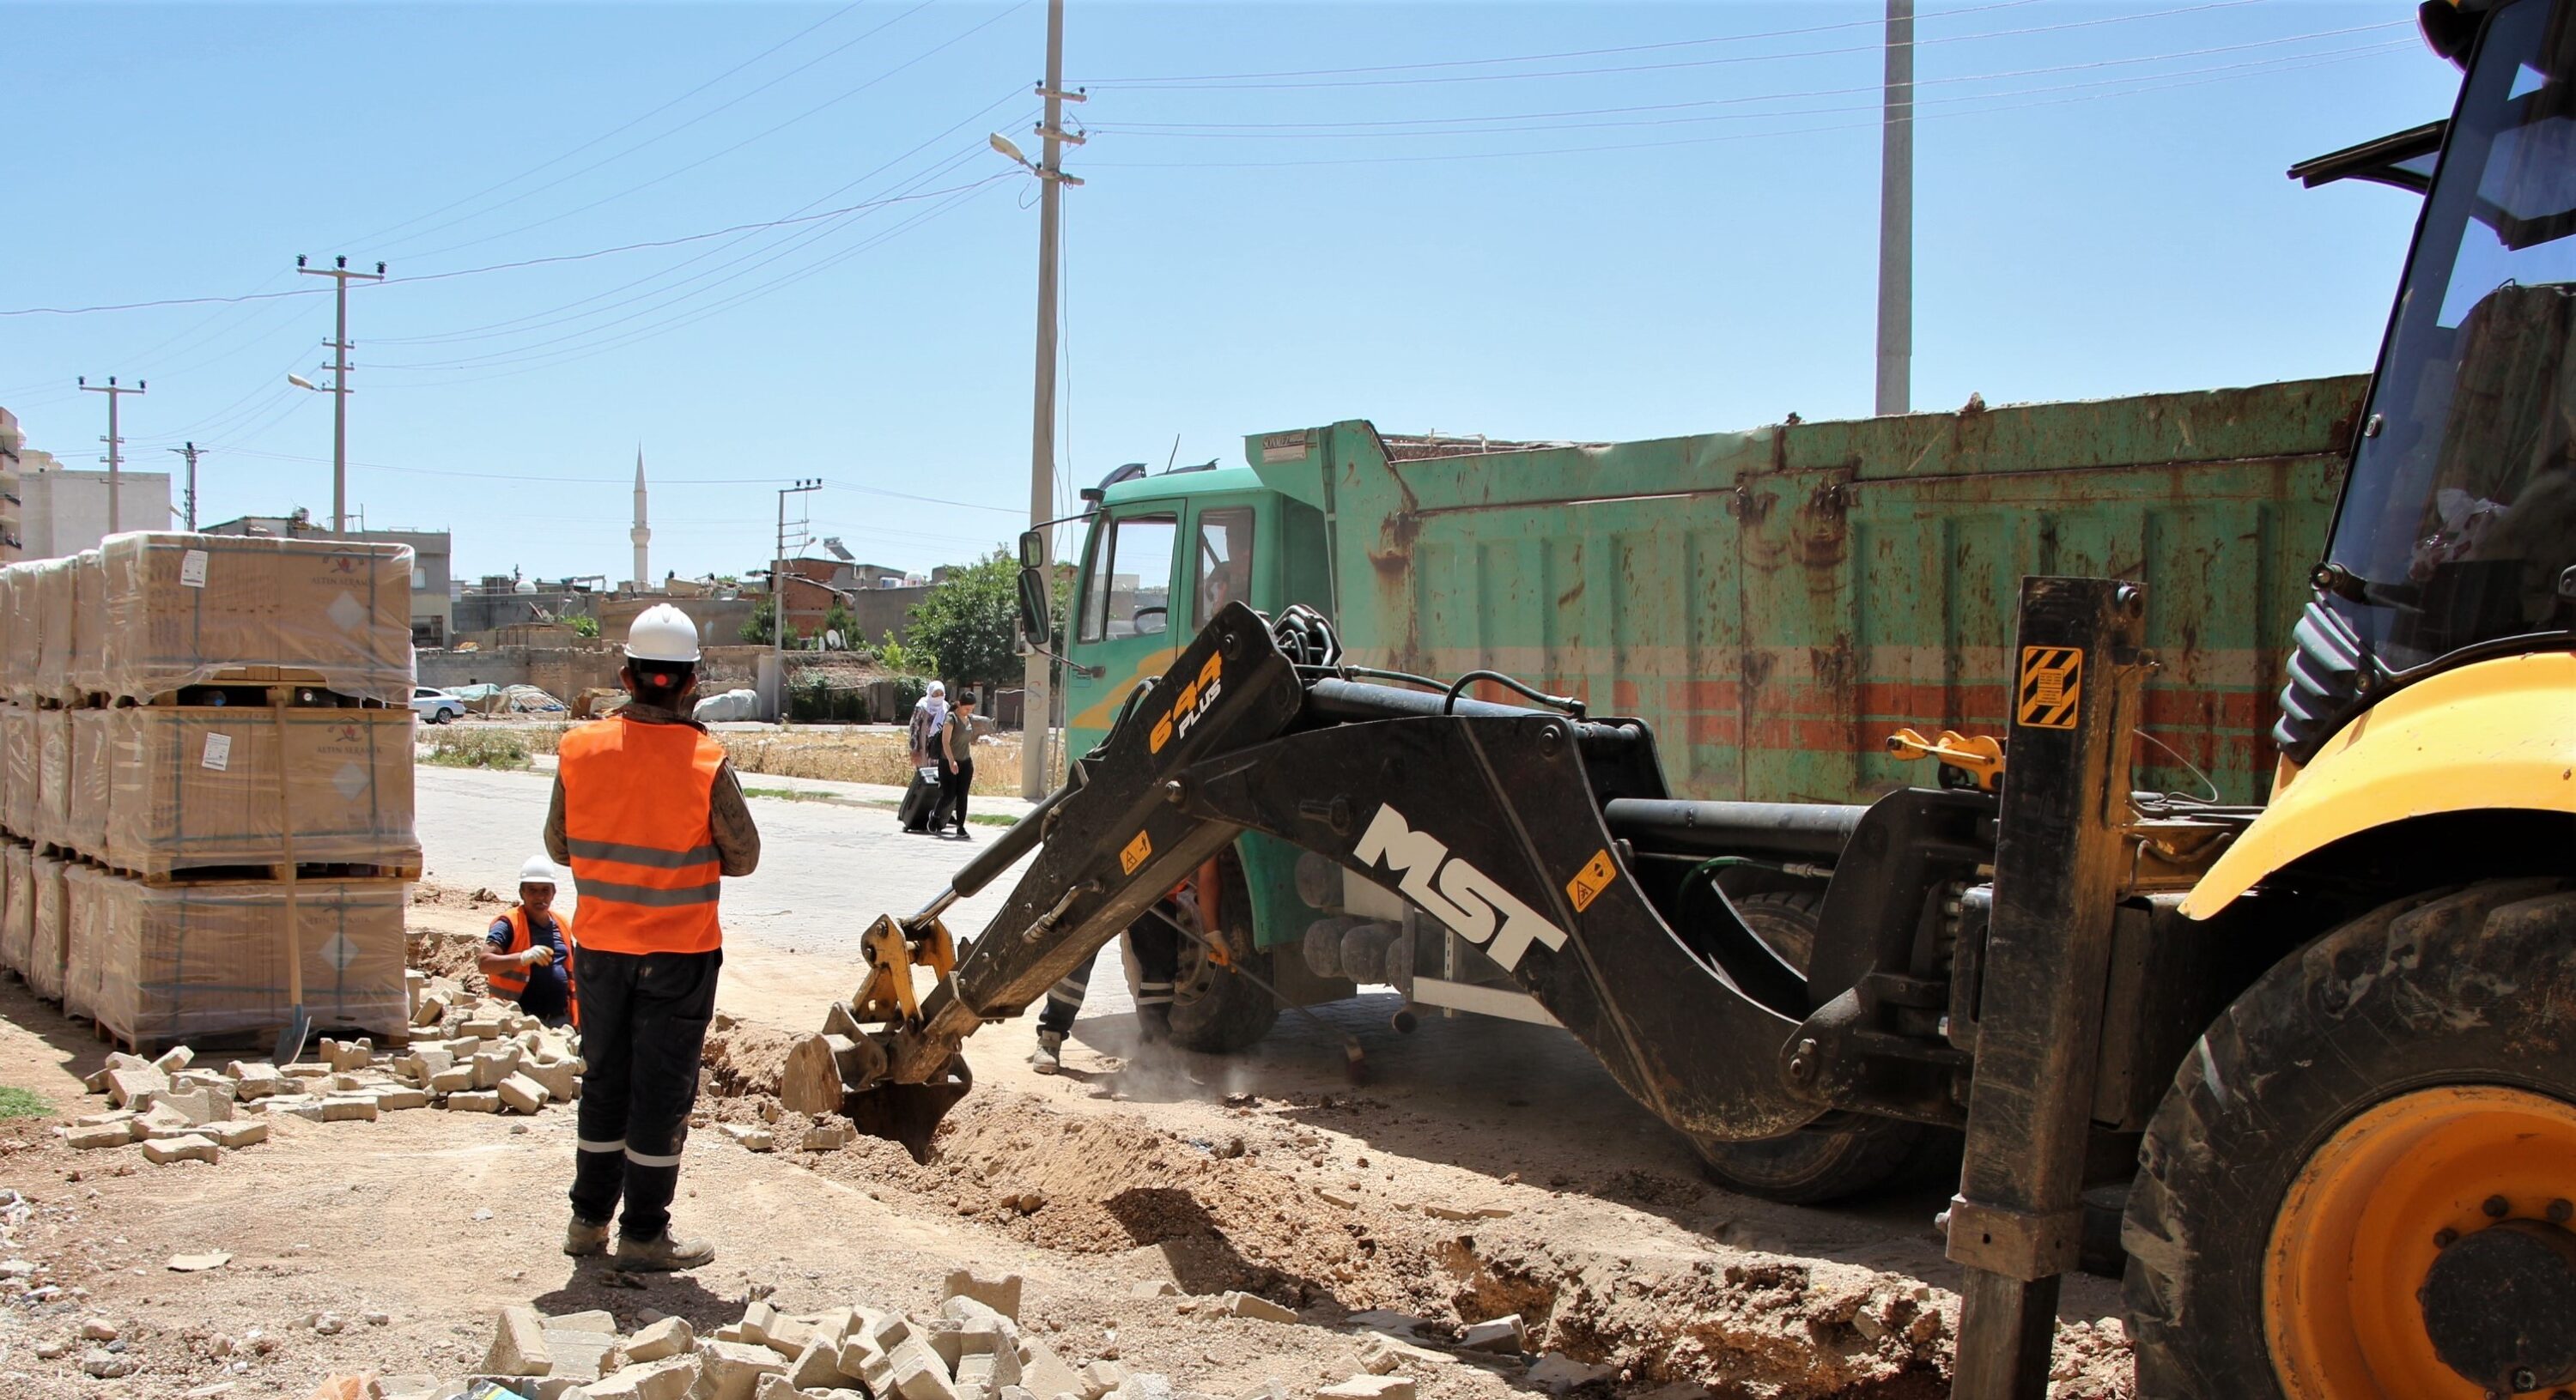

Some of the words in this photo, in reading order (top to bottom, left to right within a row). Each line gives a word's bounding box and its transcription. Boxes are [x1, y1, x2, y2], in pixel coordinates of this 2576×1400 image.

[1150, 650, 1222, 754] 644
[1178, 678, 1221, 739] PLUS
[344, 746, 384, 755] SERAMK
[1353, 803, 1568, 973] MST
